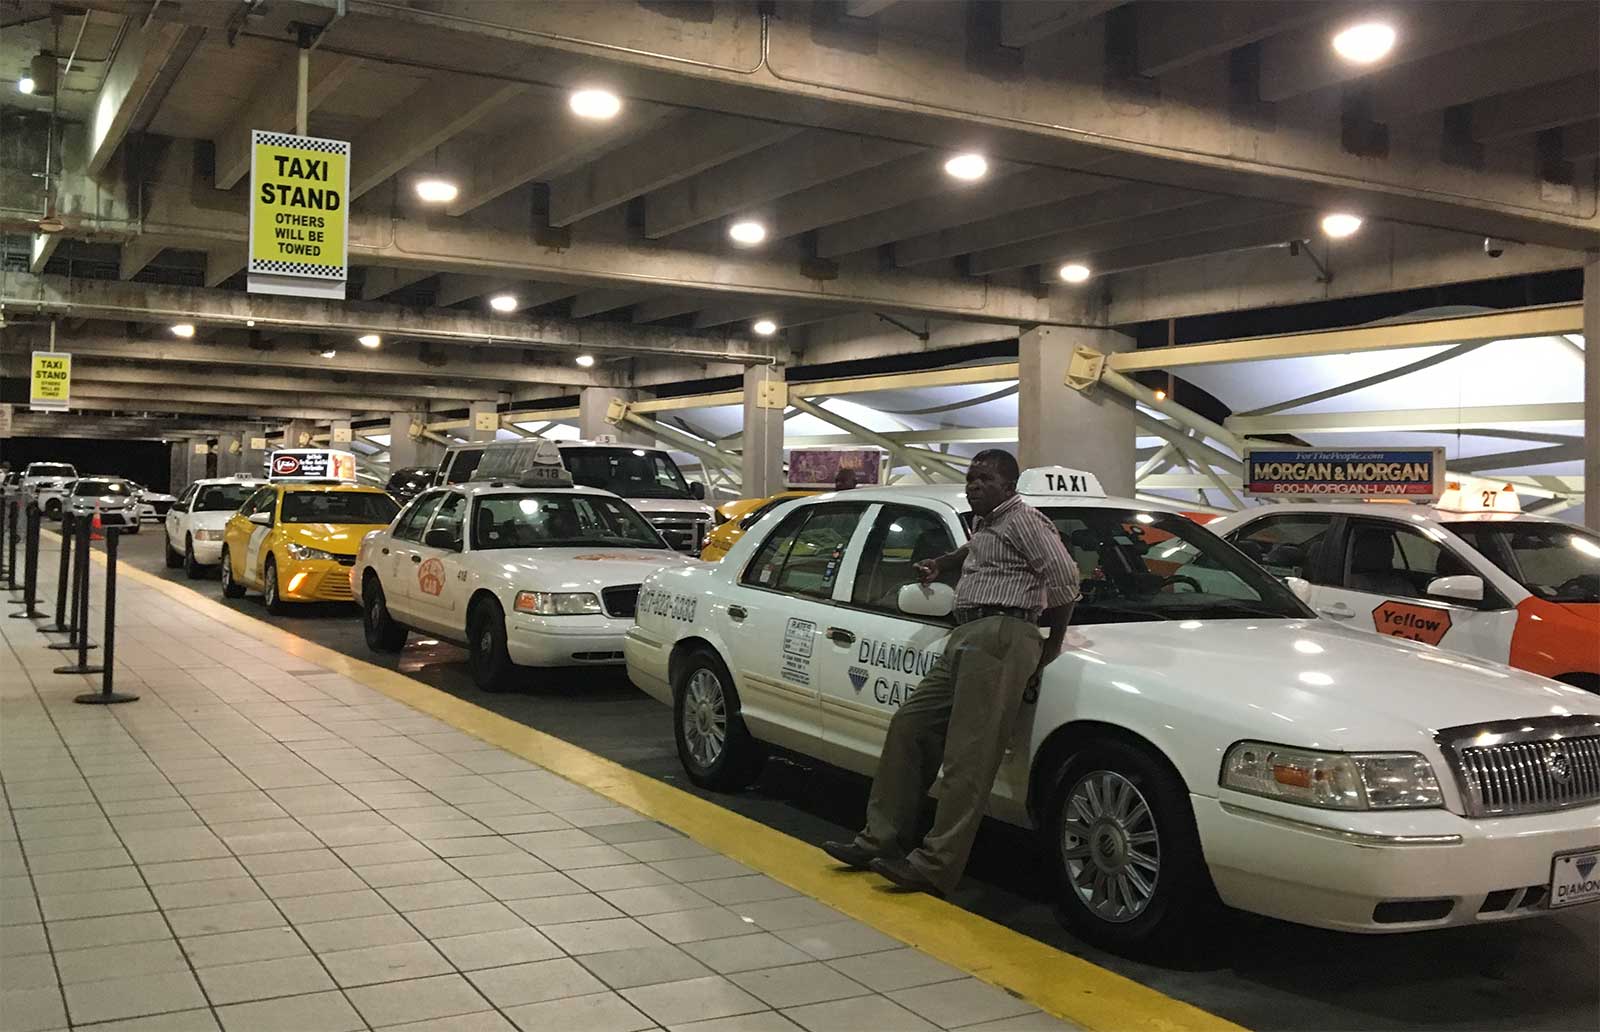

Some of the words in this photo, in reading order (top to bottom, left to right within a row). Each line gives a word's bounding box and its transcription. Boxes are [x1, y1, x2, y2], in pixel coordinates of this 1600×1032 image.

[274, 155, 328, 181] TAXI
[260, 183, 340, 211] STAND
[275, 213, 325, 228] OTHERS
[275, 228, 304, 241] WILL
[308, 231, 324, 242] BE
[277, 242, 321, 256] TOWED
[41, 360, 62, 369] TAXI
[35, 370, 67, 380] STAND
[536, 468, 559, 479] 418
[1254, 463, 1331, 481] MORGAN
[1334, 466, 1345, 481] &
[1347, 463, 1428, 481] MORGAN
[1045, 474, 1087, 492] TAXI
[1273, 484, 1407, 494] 800-MORGAN-LAW
[1482, 490, 1497, 507] 27
[1384, 610, 1440, 632] Yellow
